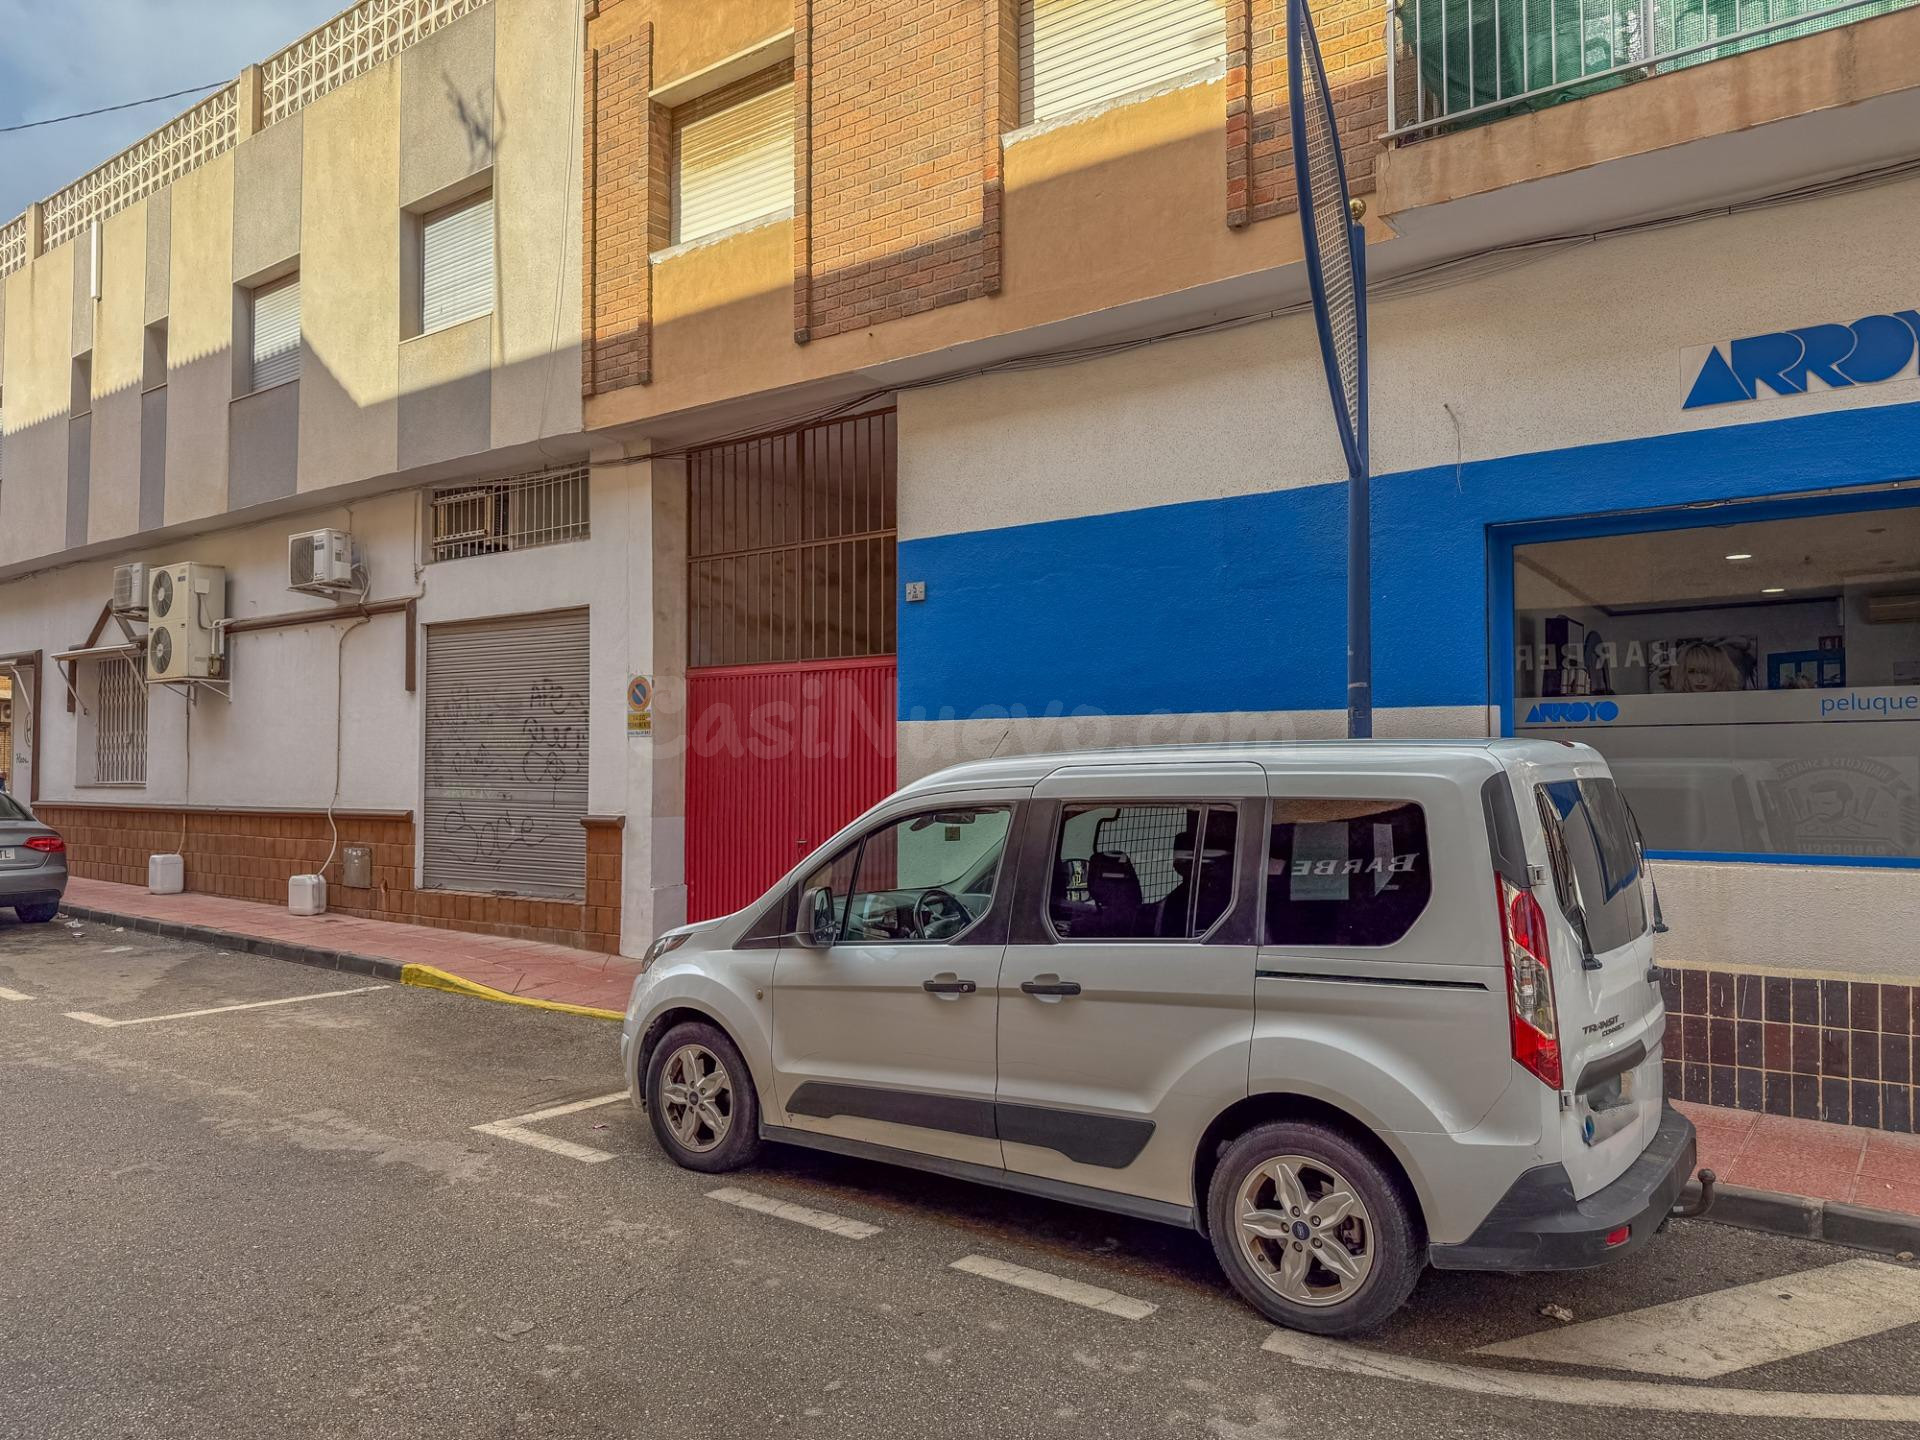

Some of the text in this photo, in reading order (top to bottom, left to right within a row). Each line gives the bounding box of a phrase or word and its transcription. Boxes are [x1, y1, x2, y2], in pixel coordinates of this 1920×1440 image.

[1525, 701, 1618, 722] ARROYO
[1821, 692, 1918, 716] peluque
[1582, 1014, 1620, 1035] TRANSIT
